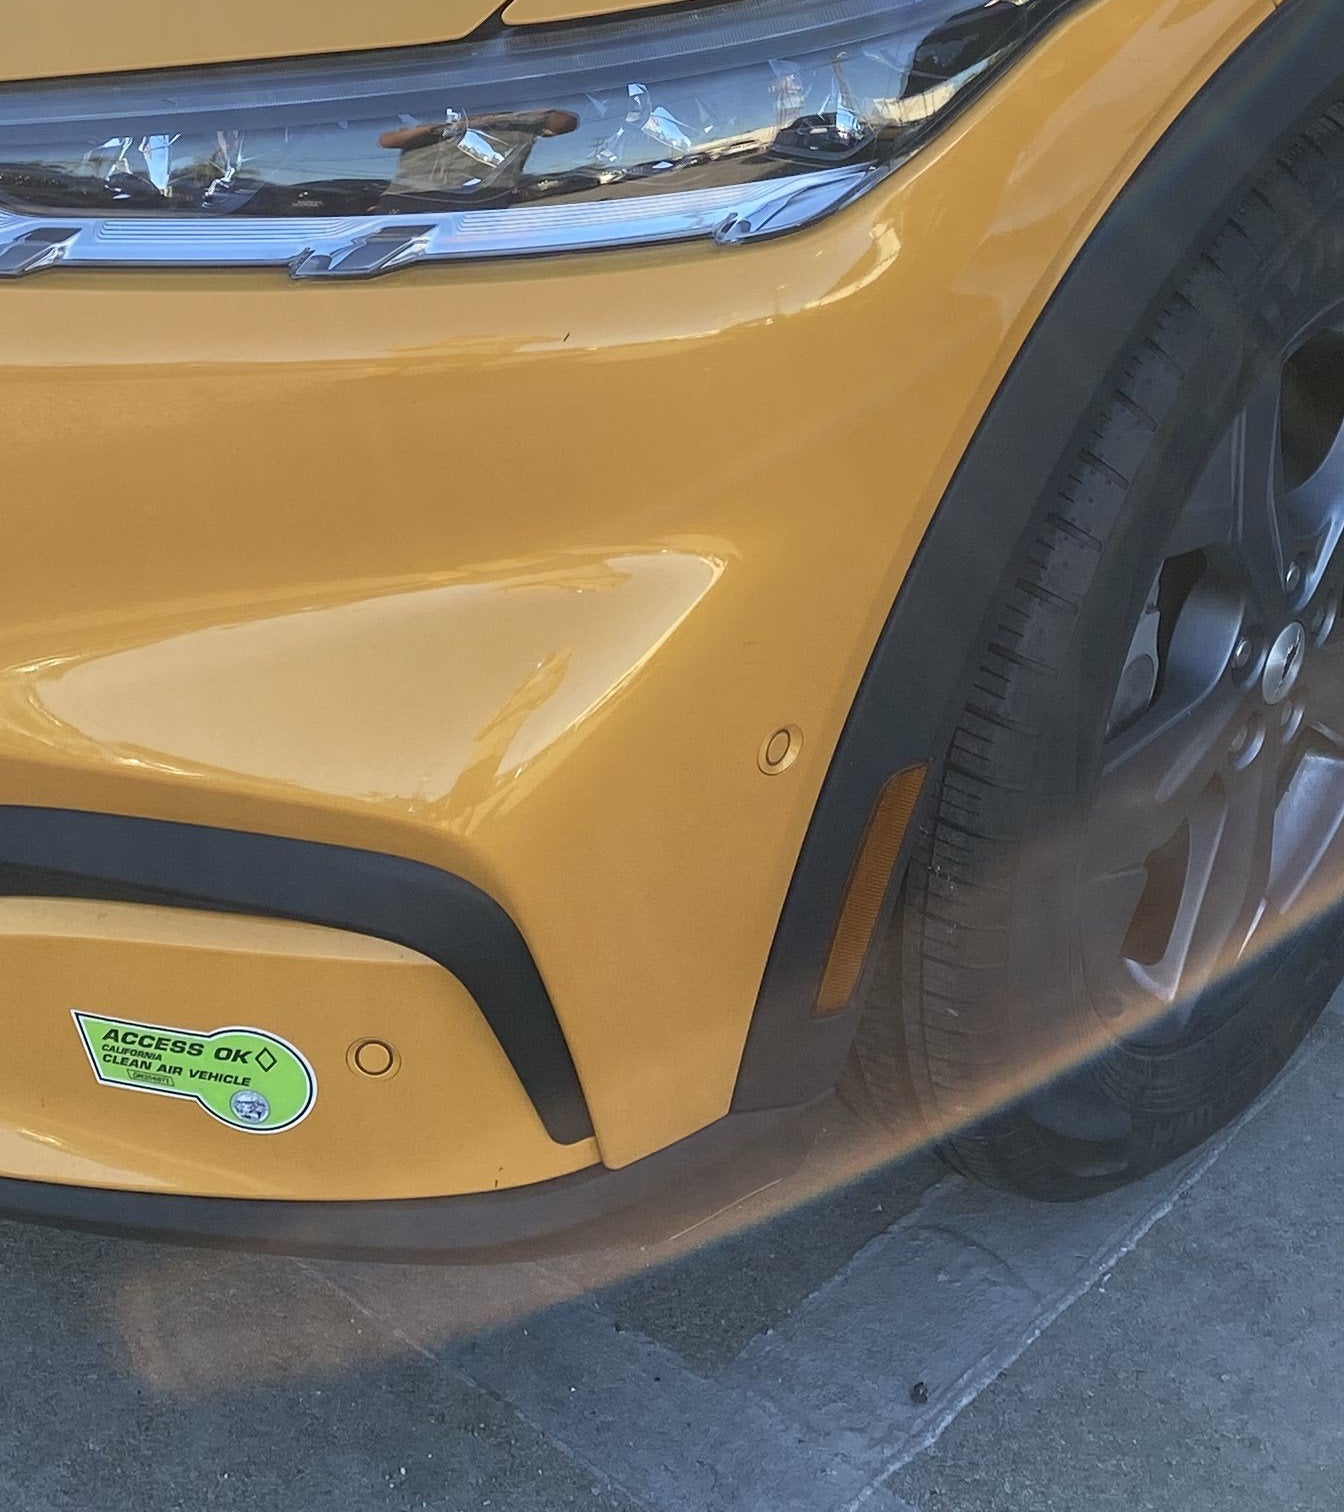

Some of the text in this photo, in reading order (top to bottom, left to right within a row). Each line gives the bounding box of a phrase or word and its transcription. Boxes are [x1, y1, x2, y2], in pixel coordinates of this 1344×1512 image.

[101, 1028, 254, 1065] ACCESS OK
[101, 1043, 163, 1062] CALIFORNIA
[102, 1053, 153, 1071] CLEAN
[156, 1063, 184, 1076] AIR
[188, 1068, 252, 1088] VEHICLE
